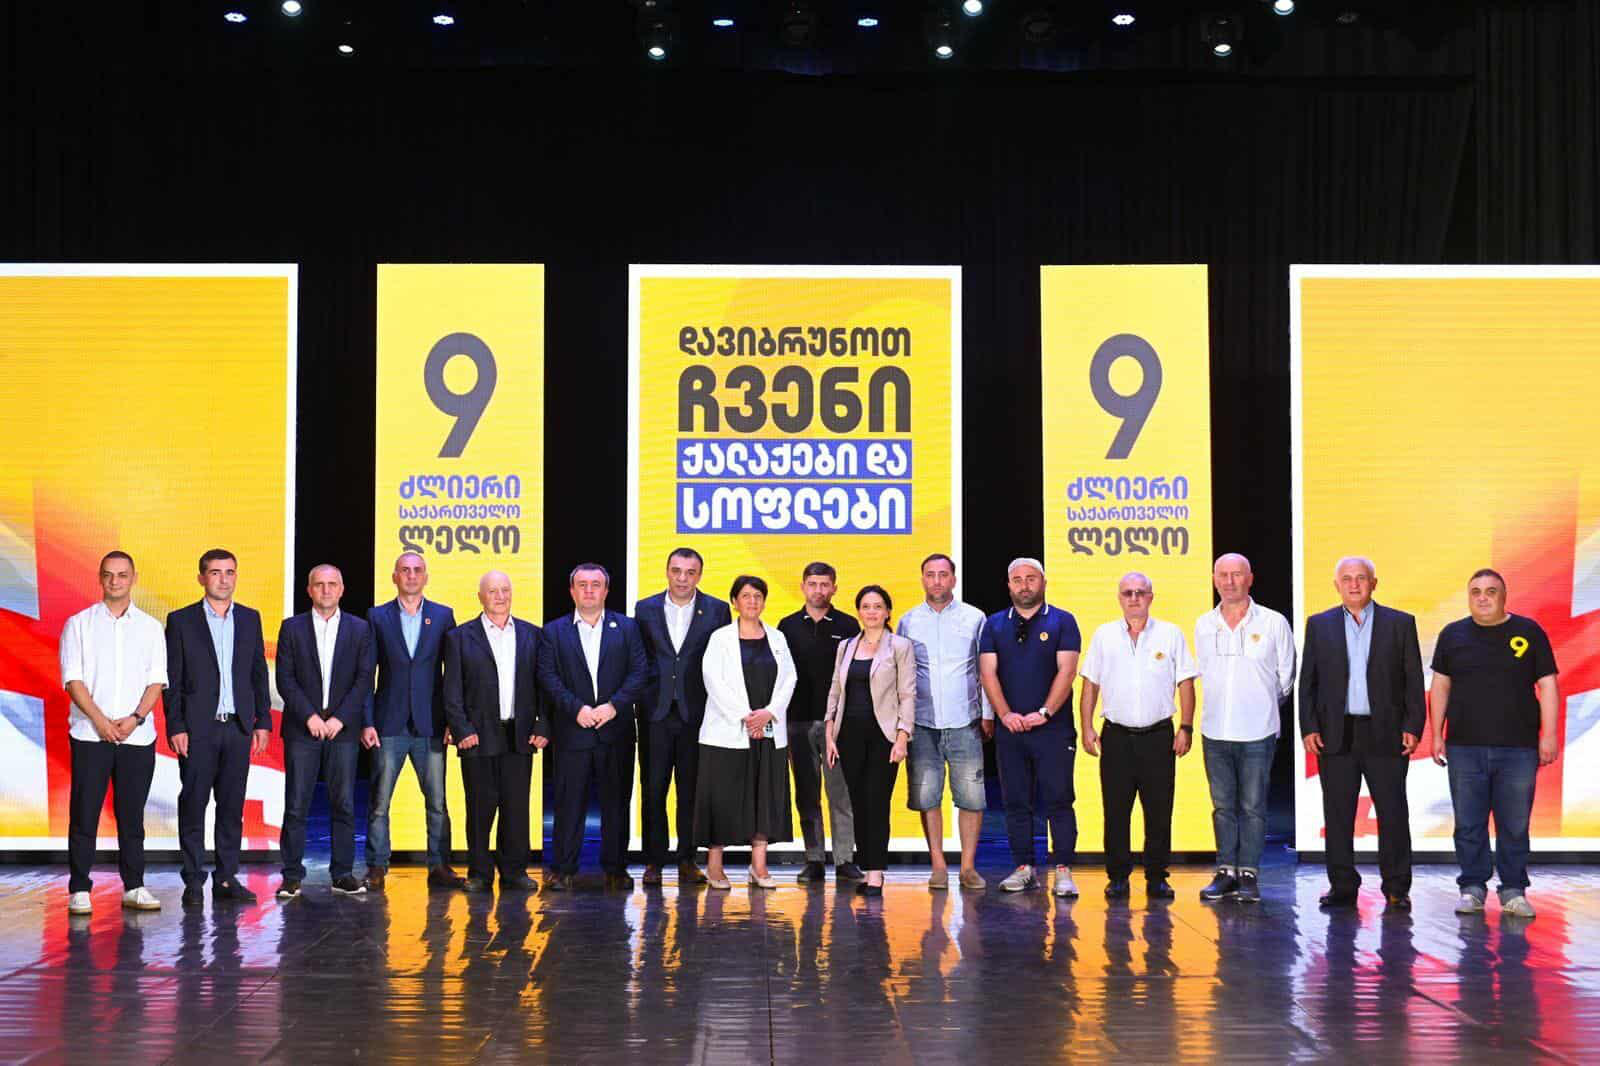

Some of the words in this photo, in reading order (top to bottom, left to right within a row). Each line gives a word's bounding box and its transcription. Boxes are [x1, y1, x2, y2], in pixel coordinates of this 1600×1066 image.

[679, 326, 911, 357] დავიბრუნოთ
[424, 332, 498, 458] 9
[678, 364, 911, 434] ჩვენი
[1089, 333, 1163, 460] 9
[682, 442, 858, 476] ქალაქები
[866, 442, 908, 476] და
[399, 474, 521, 499] ძლიერი
[1067, 476, 1189, 501] ძლიერი
[399, 504, 521, 520] საქართველო
[683, 487, 906, 530] სოფლები
[1067, 506, 1189, 521] საქართველო
[399, 525, 521, 554] ლელო
[1067, 526, 1189, 556] ლელო
[1510, 636, 1529, 658] 9
